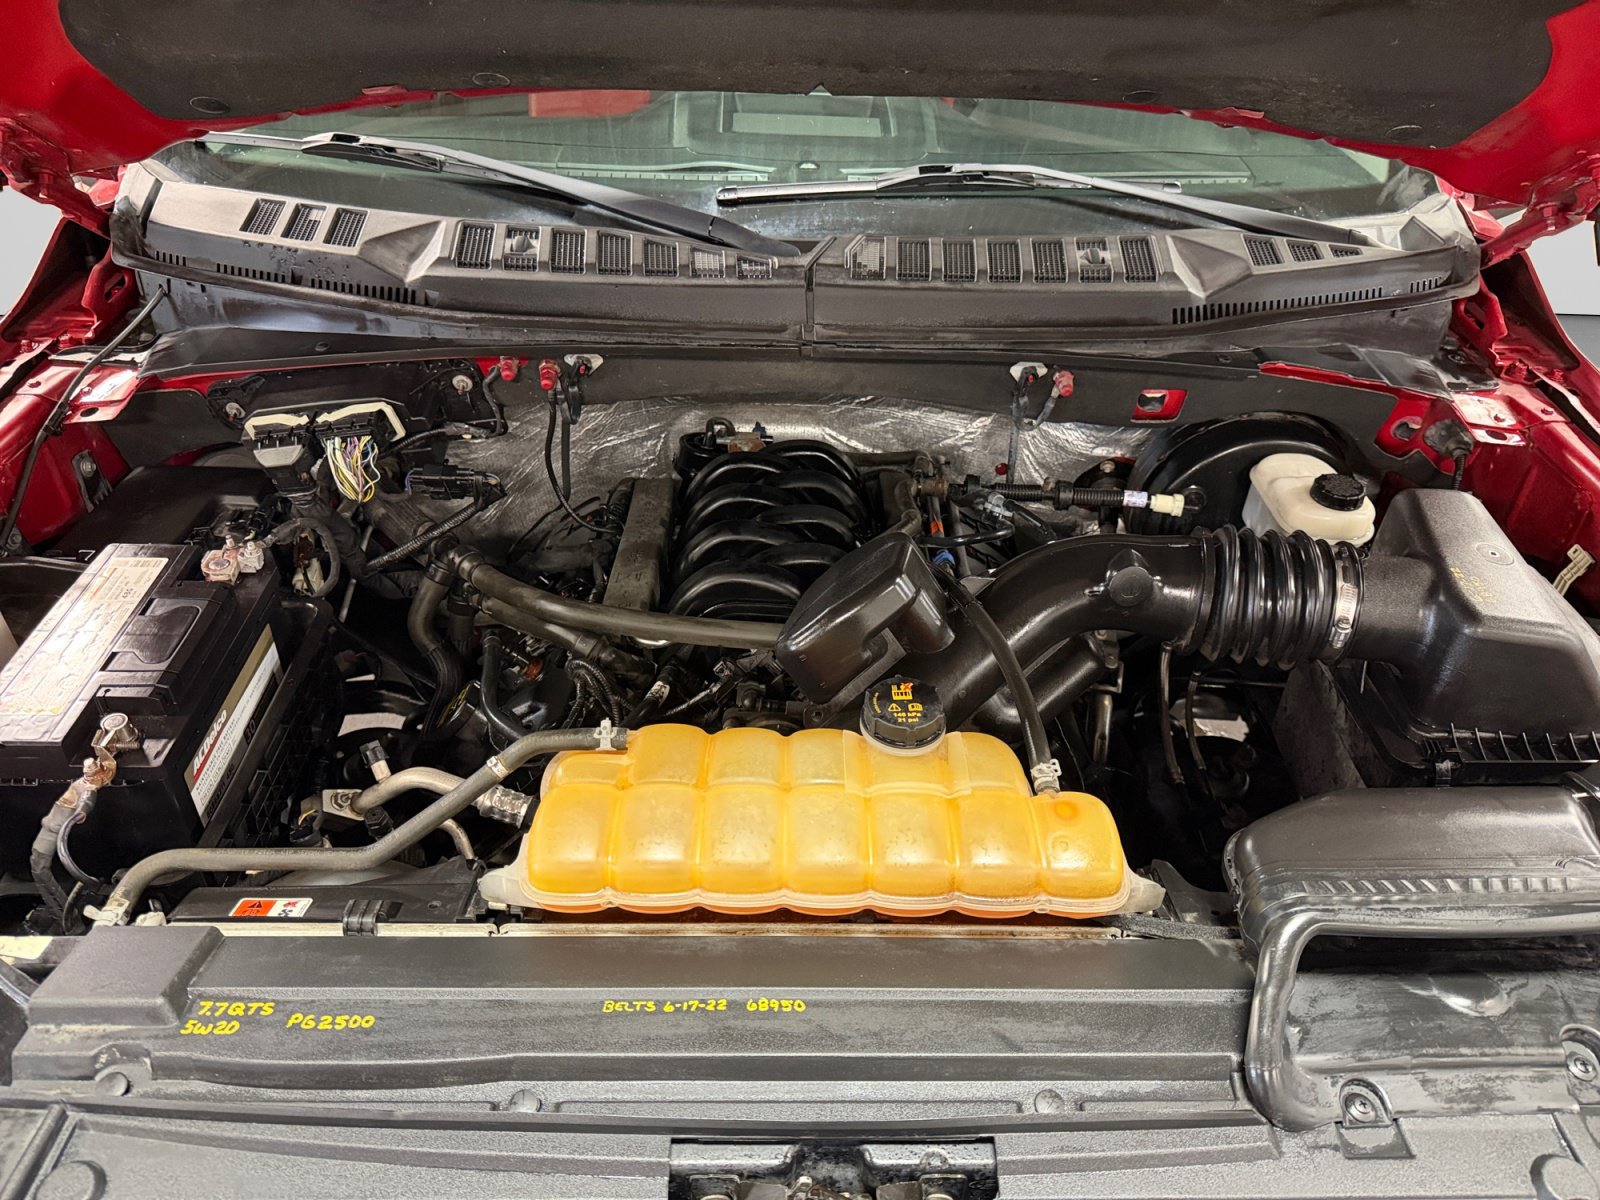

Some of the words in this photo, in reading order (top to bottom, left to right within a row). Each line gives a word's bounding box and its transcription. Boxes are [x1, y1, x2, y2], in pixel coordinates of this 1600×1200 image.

[193, 709, 228, 775] ACDelco
[198, 1001, 275, 1016] 7.7QTS
[602, 1000, 657, 1013] BELTS
[663, 999, 728, 1013] 6-17-22
